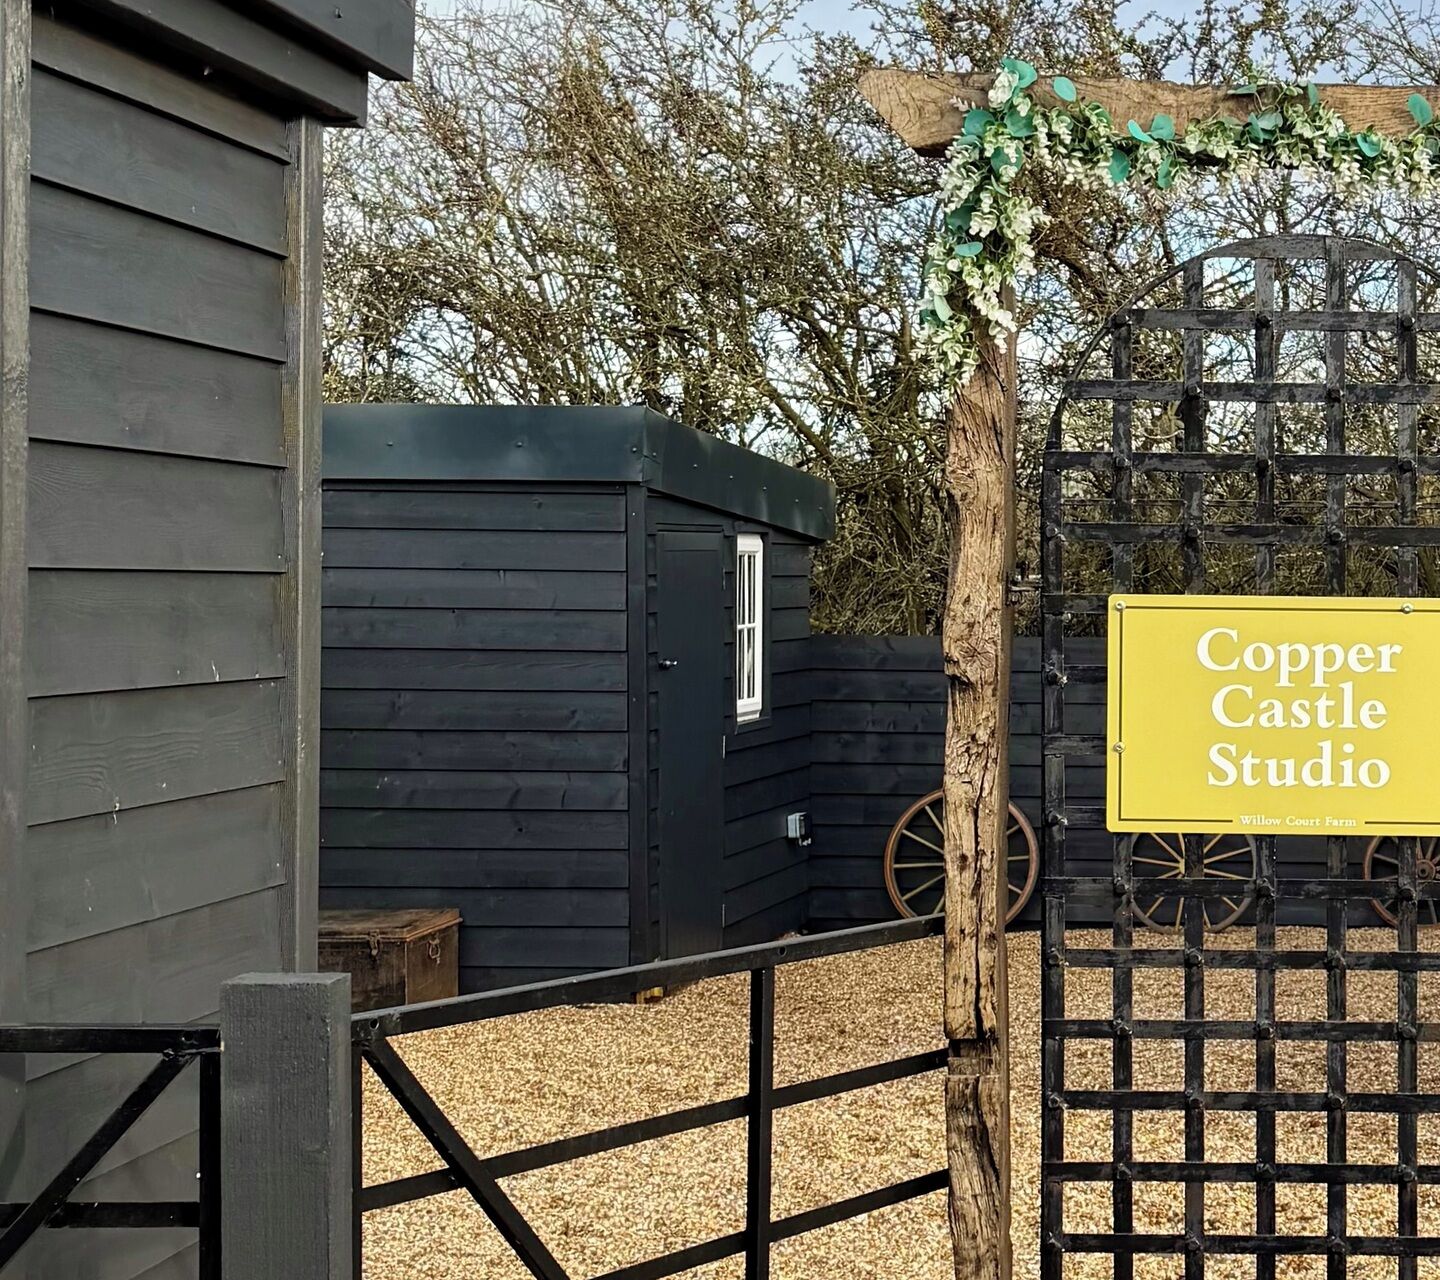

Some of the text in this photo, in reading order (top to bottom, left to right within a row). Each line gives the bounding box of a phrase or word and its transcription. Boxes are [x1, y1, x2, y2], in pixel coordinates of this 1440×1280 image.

[1196, 627, 1403, 688] Copper
[1211, 680, 1388, 730] Castle
[1207, 740, 1391, 788] Studio
[1239, 814, 1357, 828] Willow Court Farm
